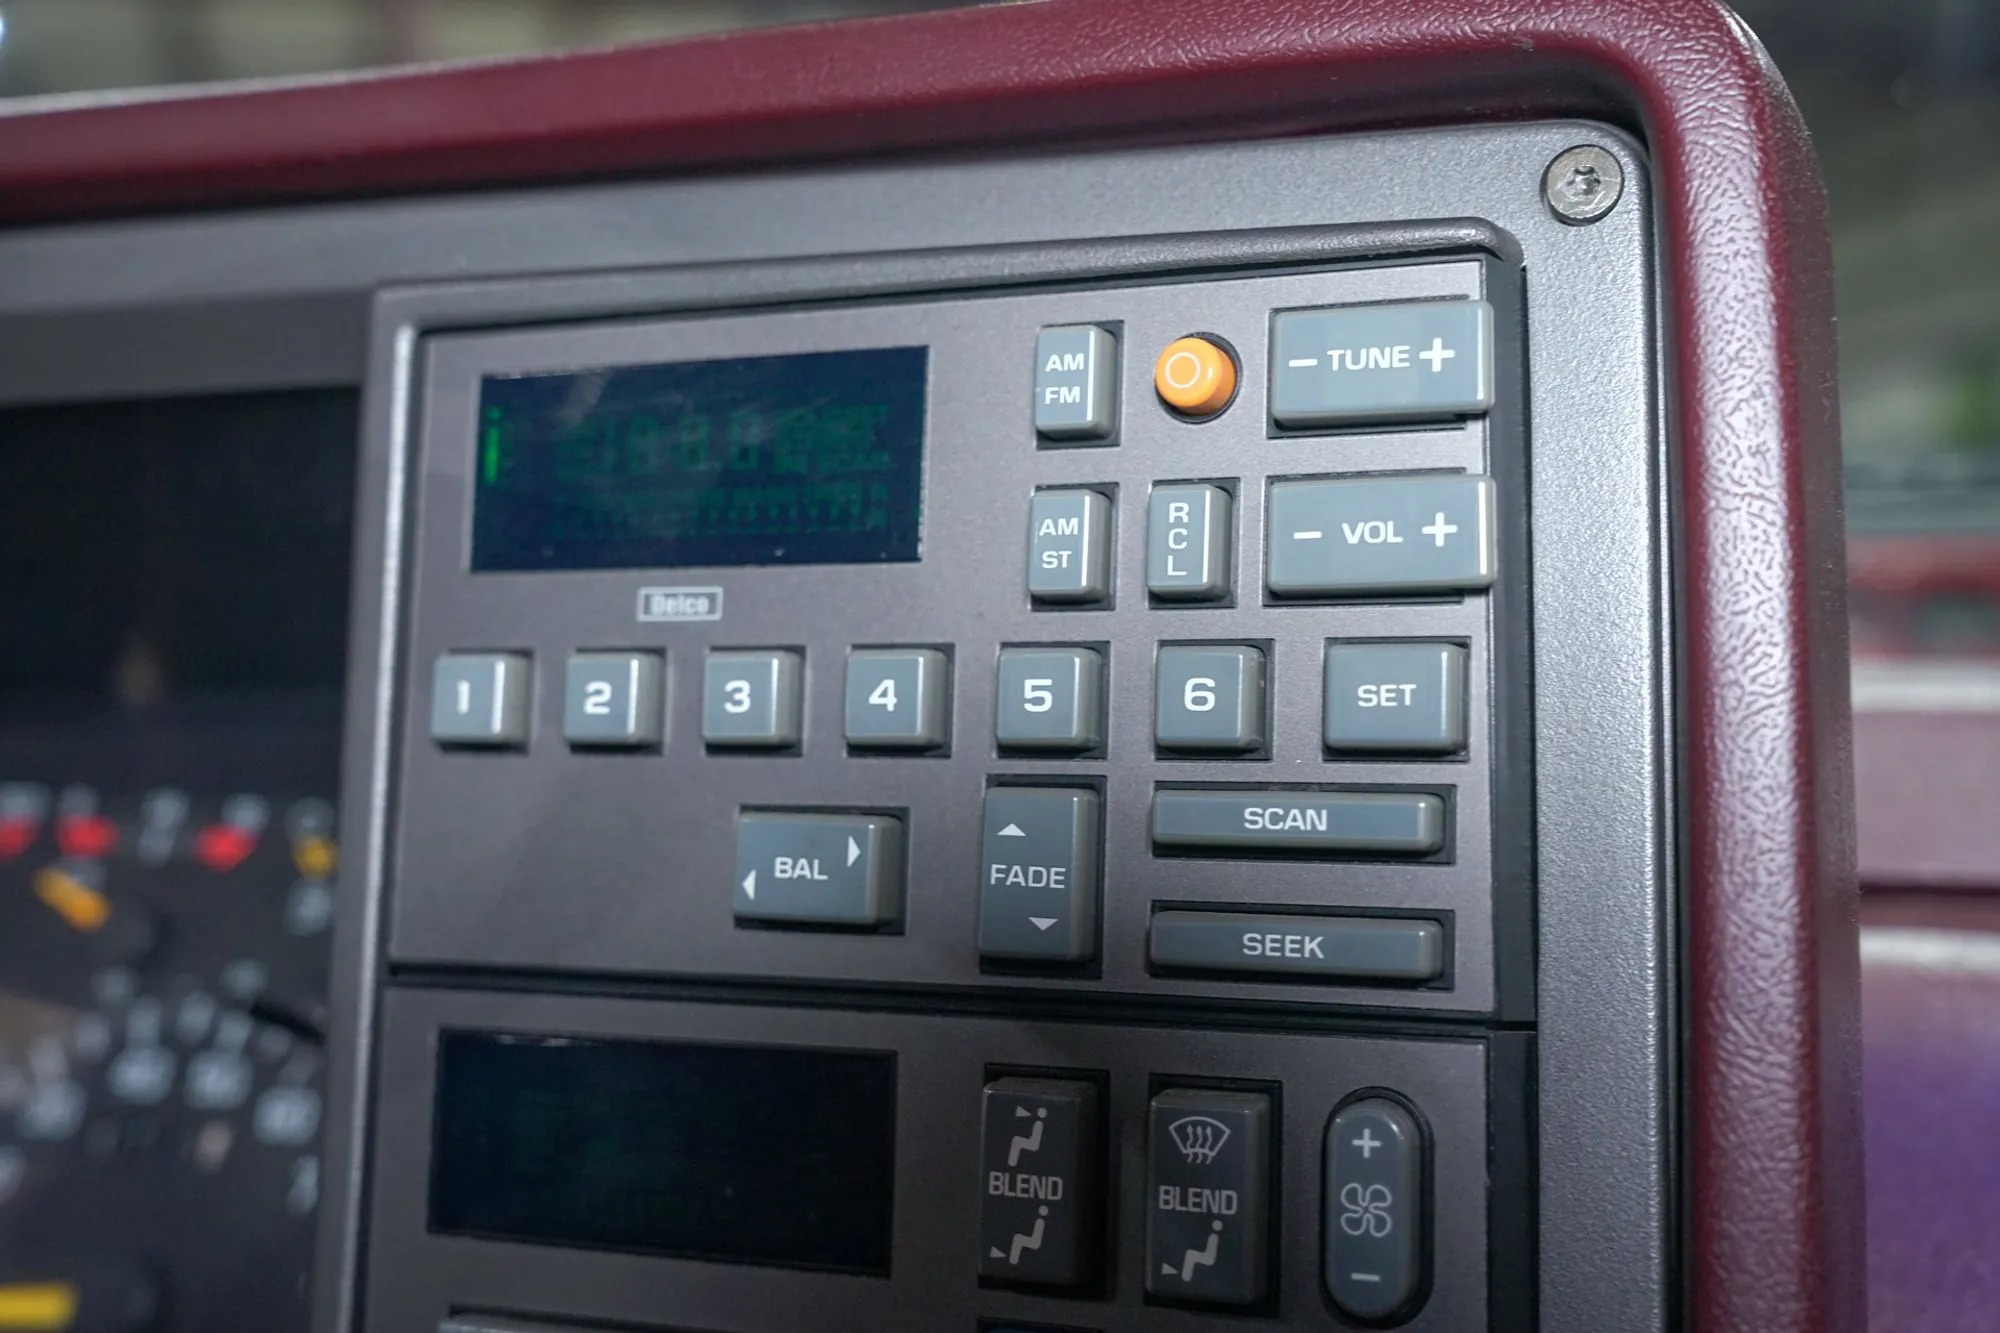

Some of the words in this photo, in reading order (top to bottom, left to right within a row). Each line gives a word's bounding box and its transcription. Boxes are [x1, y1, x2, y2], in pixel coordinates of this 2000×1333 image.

[1045, 353, 1084, 372] AM
[1327, 346, 1410, 371] TUNE
[1045, 386, 1080, 404] FM
[1039, 518, 1078, 536] AM
[1342, 521, 1403, 544] VOL
[1042, 551, 1072, 568] ST
[457, 681, 470, 714] 1
[585, 682, 611, 714] 2
[725, 680, 750, 712] 3
[869, 680, 897, 711] 4
[1024, 679, 1052, 712] 5
[1185, 678, 1215, 711] 6
[1358, 684, 1416, 706] SET
[1245, 808, 1327, 830] SCAN
[775, 857, 828, 879] BAL
[991, 864, 1065, 888] FADE
[1244, 934, 1324, 958] SEEK
[989, 1172, 1062, 1200] BLEND
[1159, 1186, 1237, 1214] BLEND
